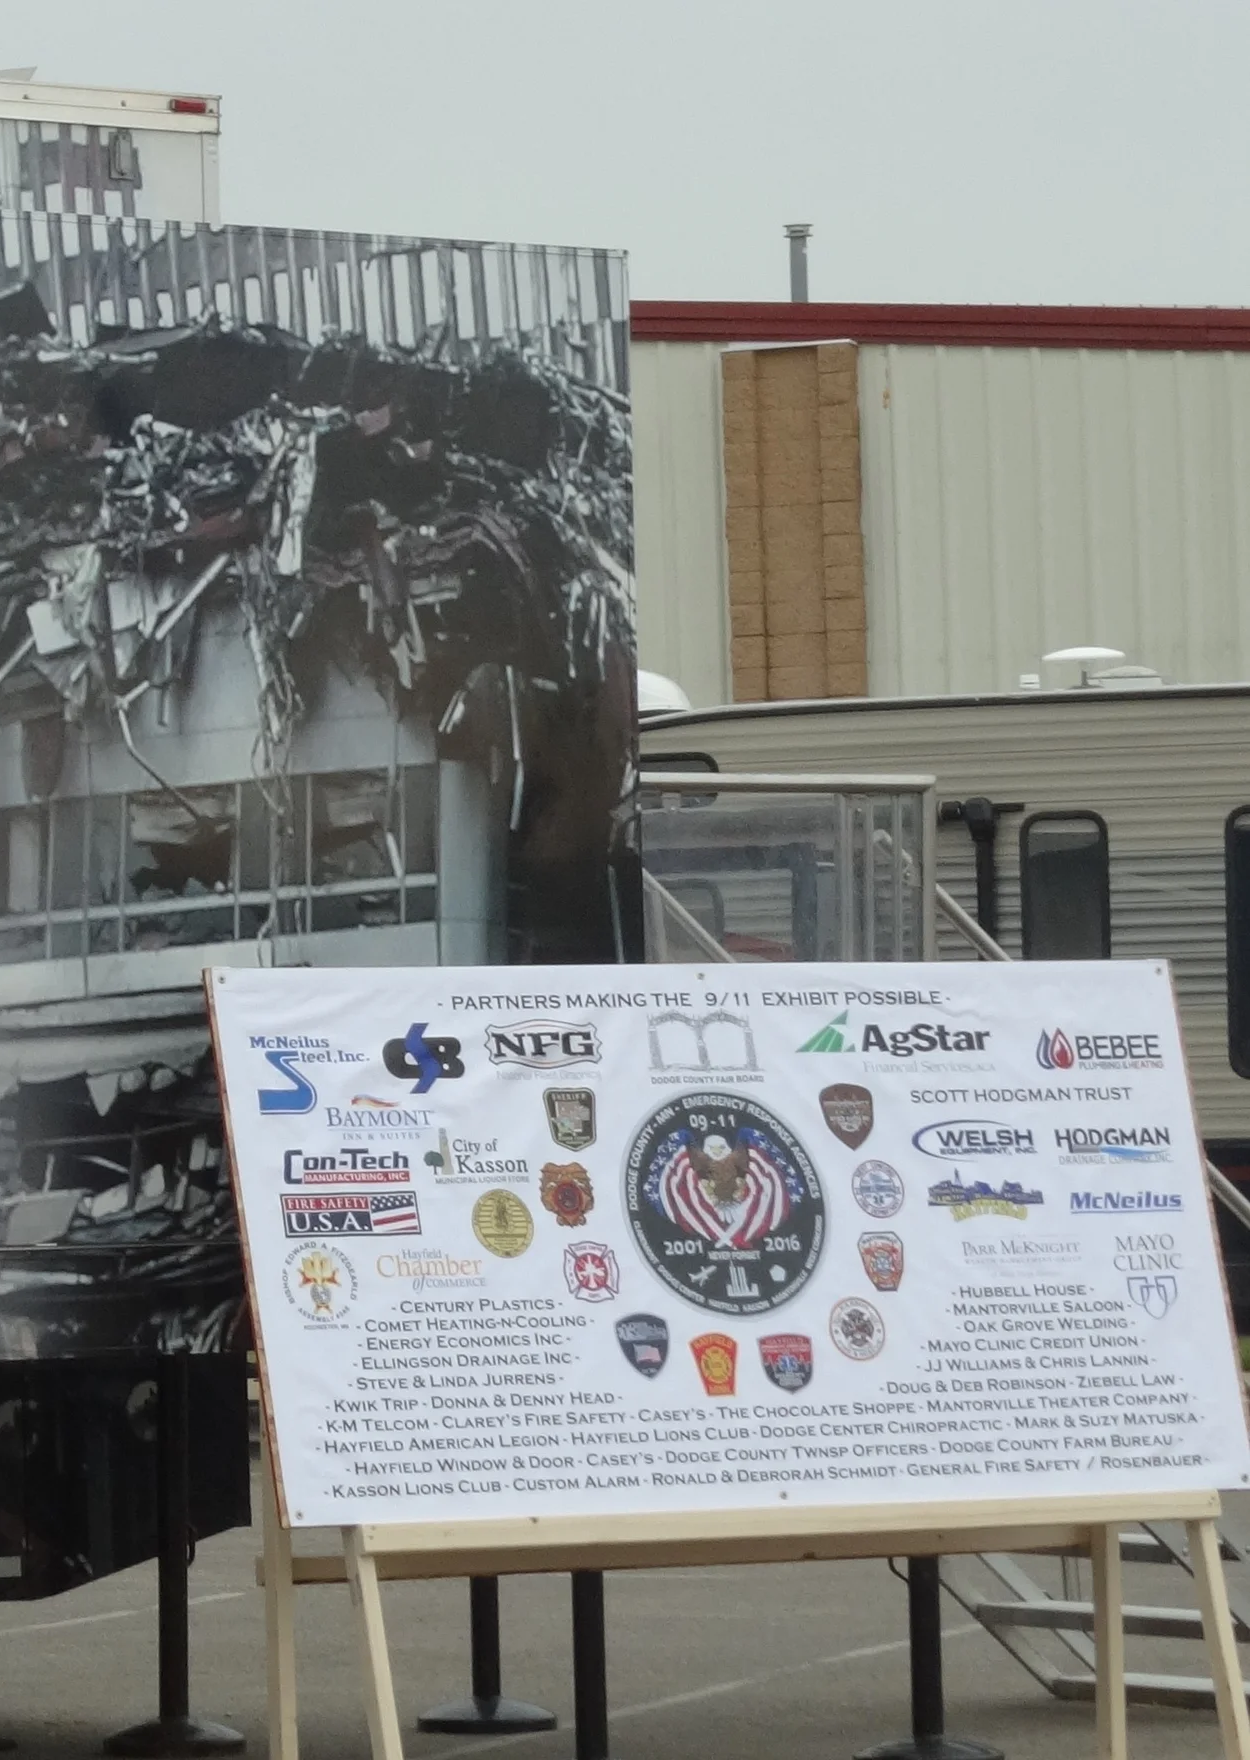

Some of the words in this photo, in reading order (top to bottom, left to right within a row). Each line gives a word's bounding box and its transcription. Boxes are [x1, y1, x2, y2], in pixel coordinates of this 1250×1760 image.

[452, 995, 561, 1010] PARTNERS
[566, 993, 647, 1008] MAKING
[651, 993, 692, 1007] THE
[704, 992, 749, 1007] 9/11
[762, 992, 839, 1006] EXHIBIT
[844, 991, 942, 1005] POSSIBLE
[249, 1036, 329, 1049] McNeilus
[491, 1032, 596, 1058] NFG
[861, 1022, 990, 1056] AgStar
[1075, 1034, 1162, 1059] BEBEE
[651, 1076, 682, 1085] DODGE
[683, 1075, 714, 1084] COUNTY
[736, 1075, 764, 1083] BOARD
[682, 1095, 746, 1110] EMERGENCY
[910, 1089, 969, 1104] SCOTT
[974, 1088, 1071, 1102] HODGMAN
[1073, 1087, 1132, 1101] TRUST
[325, 1107, 432, 1127] BAYMONT
[655, 1107, 675, 1127] MN
[689, 1114, 736, 1131] 09-11
[747, 1104, 795, 1146] RESPONSE
[452, 1139, 481, 1156] City
[485, 1138, 498, 1152] of
[630, 1121, 656, 1167] COUNTY
[936, 1129, 1033, 1147] WELSH
[1054, 1127, 1170, 1151] HODGMAN
[284, 1148, 409, 1184] Con-Tech
[457, 1155, 528, 1174] Kasson
[790, 1144, 821, 1200] AGENCIES
[304, 1172, 381, 1183] MANUFACTURING,
[628, 1166, 639, 1211] DODGE
[286, 1199, 317, 1211] FIRE
[321, 1197, 368, 1210] SAFETY
[1070, 1190, 1182, 1208] McNeilus
[290, 1211, 370, 1232] U.S.A.
[663, 1240, 704, 1255] 2001
[765, 1235, 800, 1252] 2016
[962, 1241, 997, 1256] PARR
[1115, 1234, 1174, 1251] MAYO
[402, 1248, 443, 1260] Hayfield
[1113, 1252, 1183, 1272] CLINIC
[376, 1253, 482, 1278] Chamber
[412, 1274, 426, 1294] of
[426, 1276, 487, 1288] COMMERCE
[959, 1286, 1031, 1299] HUBBELL
[1035, 1284, 1087, 1296] HOUSE
[400, 1300, 474, 1314] CENTURY
[479, 1298, 555, 1312] PLASTICS
[953, 1302, 1060, 1316] MANTORVILLE
[1063, 1300, 1124, 1313] SALOON
[365, 1319, 422, 1332] COMET
[426, 1315, 586, 1331] HEATING-N-COOLING
[963, 1320, 998, 1333] OAK
[1001, 1319, 1055, 1332] GROVE
[1058, 1317, 1128, 1330] WELDING
[366, 1337, 432, 1350] ENERGY
[436, 1335, 531, 1348] ECONOMICS
[534, 1333, 563, 1345] INC
[928, 1339, 971, 1352] MAYO
[974, 1338, 1026, 1351] CLINIC
[1029, 1337, 1085, 1350] CREDIT
[1089, 1335, 1138, 1348] UNION
[361, 1356, 453, 1370] ELLINGSON
[456, 1354, 541, 1367] DRAINAGE
[544, 1352, 571, 1364] INC
[924, 1359, 942, 1372] JJ
[946, 1359, 1022, 1371] WILLIAMS
[1025, 1356, 1036, 1369] &
[1039, 1356, 1087, 1369] CHRIS
[1090, 1355, 1149, 1367] LANNIN
[356, 1377, 409, 1391] STEVE
[413, 1375, 426, 1389] &
[429, 1375, 478, 1388] LINDA
[482, 1373, 556, 1387] JURRENS
[886, 1381, 932, 1394] DOUG
[935, 1380, 948, 1393] &
[951, 1379, 983, 1392] DEB
[986, 1378, 1066, 1391] ROBINSON
[1076, 1375, 1138, 1388] ZIEBELL
[1141, 1374, 1175, 1386] LAW
[334, 1400, 378, 1413] KWIK
[381, 1397, 418, 1411] TRIP
[431, 1396, 490, 1409] DONNA
[493, 1394, 506, 1408] &
[510, 1393, 564, 1406] DENNY
[570, 1392, 614, 1405] HEAD
[326, 1419, 358, 1433] K-M
[361, 1418, 429, 1432] TELCOM
[442, 1415, 521, 1429] CLAREY'S
[525, 1413, 563, 1426] FIRE
[566, 1411, 625, 1425] SAFETY
[638, 1408, 706, 1422] CASEY'S
[716, 1406, 750, 1419] THE
[753, 1405, 849, 1418] CHOCOLATE
[853, 1402, 916, 1415] SHOPPE
[926, 1398, 1036, 1412] MANTORVILLE
[1038, 1396, 1110, 1409] THEATER
[1113, 1393, 1188, 1406] COMPANY
[324, 1440, 404, 1454] HAYFIELD
[409, 1437, 494, 1451] AMERICAN
[498, 1435, 559, 1448] LEGION
[571, 1432, 649, 1445] HAYFIELD
[653, 1429, 701, 1442] LIONS
[704, 1427, 750, 1440] CLUB
[759, 1425, 817, 1438] DODGE
[820, 1423, 884, 1436] CENTER
[887, 1419, 1003, 1434] CHIROPRACTIC
[1014, 1416, 1060, 1429] MARK
[1064, 1415, 1076, 1428] &
[1079, 1414, 1119, 1428] SUZY
[1123, 1412, 1198, 1425] MATUSKA
[354, 1462, 433, 1475] HAYFIELD
[436, 1458, 507, 1472] WINDOW
[512, 1456, 525, 1470] &
[528, 1456, 575, 1469] DOOR
[586, 1452, 654, 1467] CASEY'S
[665, 1450, 721, 1464] DODGE
[724, 1448, 787, 1461] COUNTY
[790, 1445, 849, 1459] TWNSP
[852, 1444, 929, 1457] OFFICERS
[939, 1441, 994, 1454] DODGE
[997, 1438, 1058, 1452] COUNTY
[1063, 1436, 1107, 1449] FARM
[1110, 1434, 1173, 1448] BUREAU
[332, 1485, 401, 1498] KASSON
[405, 1482, 454, 1495] LIONS
[458, 1480, 502, 1494] CLUB
[513, 1478, 580, 1491] CUSTOM
[585, 1475, 640, 1488] ALARM
[651, 1472, 717, 1486] RONALD
[721, 1470, 733, 1483] &
[737, 1469, 824, 1483] DEBRORAH
[827, 1466, 897, 1480] SCHMIDT
[907, 1463, 982, 1476] GENERAL
[984, 1460, 1021, 1473] FIRE
[1024, 1458, 1080, 1472] SAFETY
[1100, 1454, 1202, 1469] ROSENBAUER
